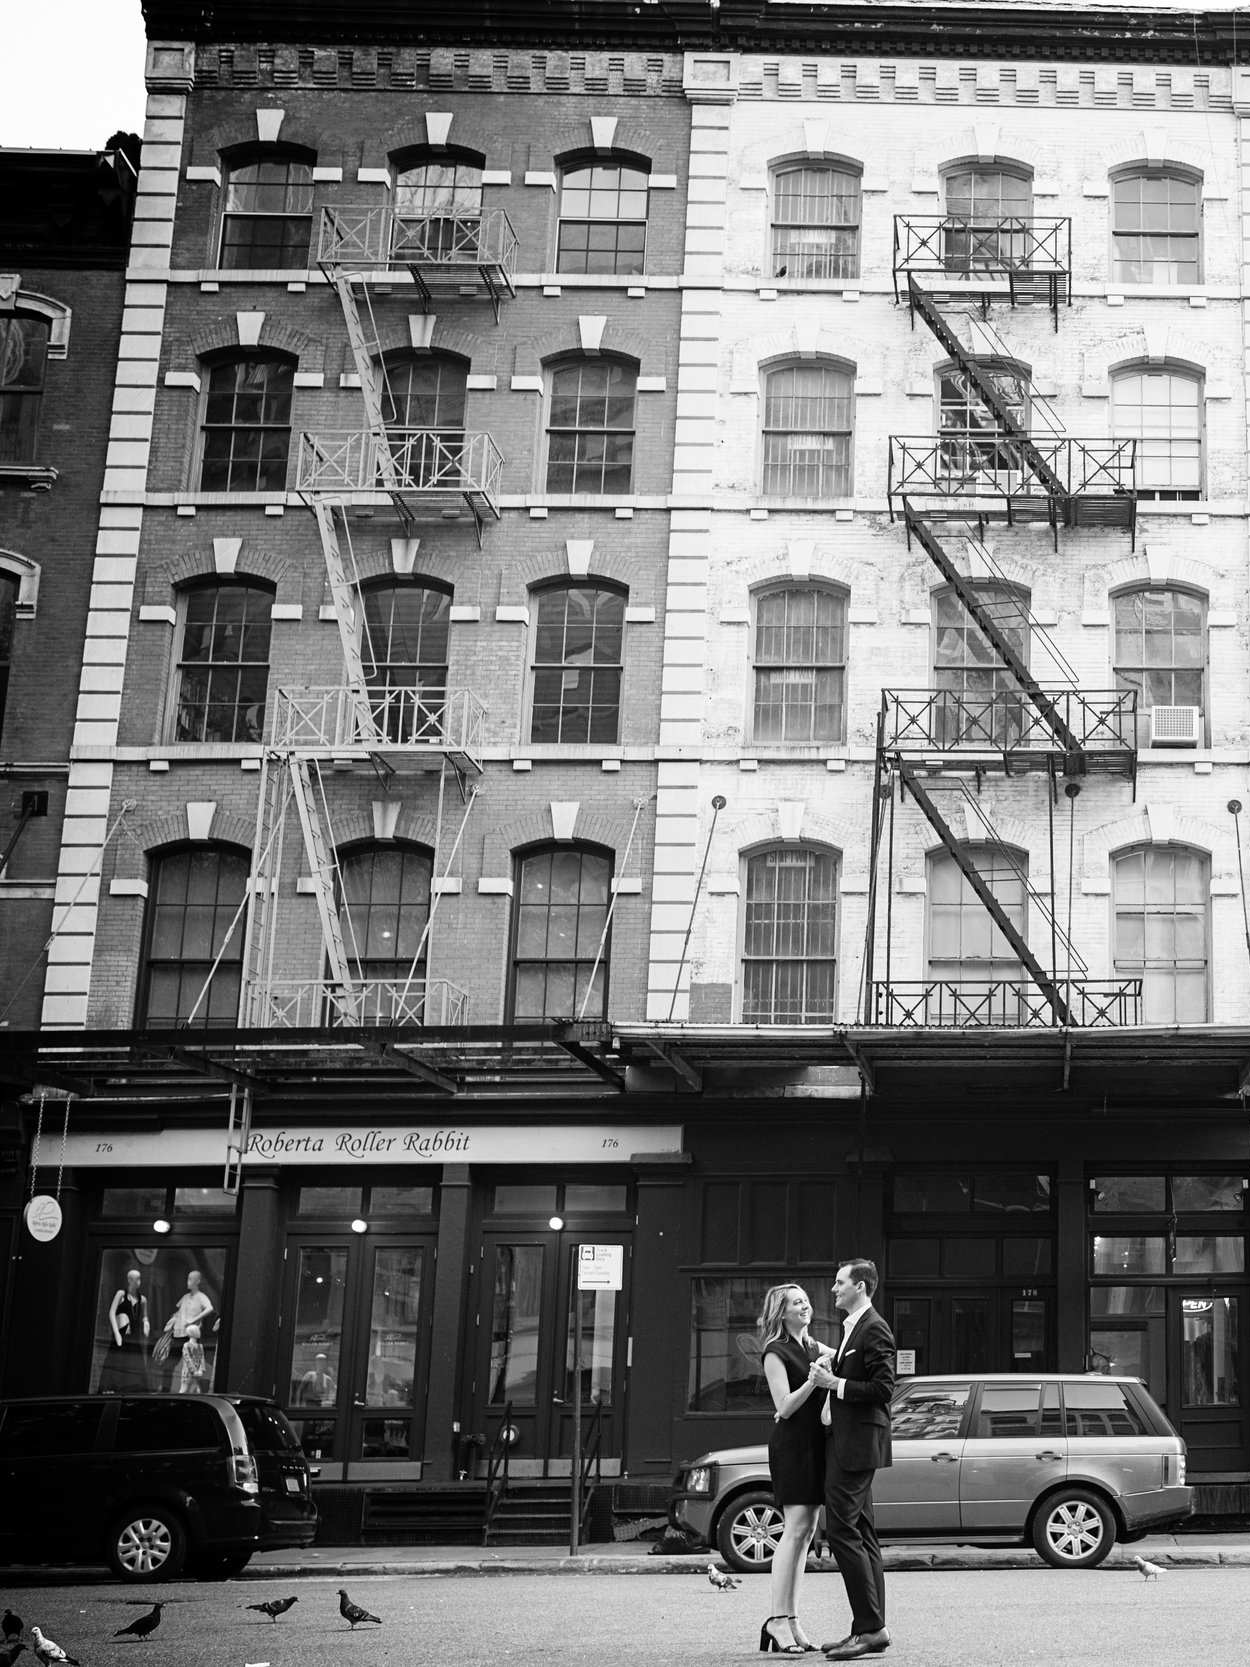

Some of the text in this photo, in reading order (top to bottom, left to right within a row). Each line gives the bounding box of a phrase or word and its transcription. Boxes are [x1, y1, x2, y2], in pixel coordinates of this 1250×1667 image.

[95, 1143, 113, 1152] 176
[248, 1130, 470, 1159] Roberta Roller Rabbit
[602, 1139, 619, 1147] 176
[1182, 1299, 1207, 1310] PEN
